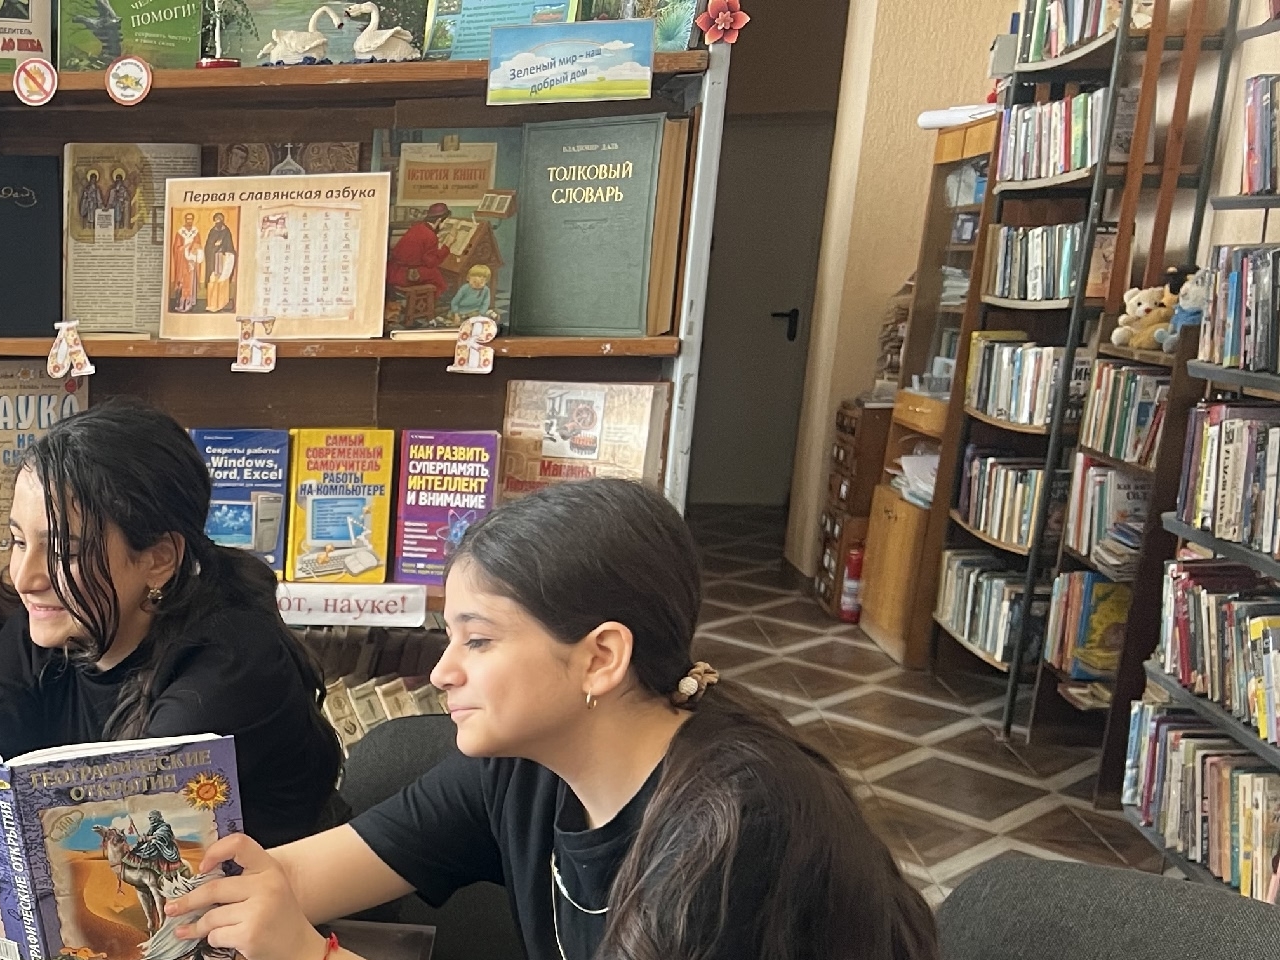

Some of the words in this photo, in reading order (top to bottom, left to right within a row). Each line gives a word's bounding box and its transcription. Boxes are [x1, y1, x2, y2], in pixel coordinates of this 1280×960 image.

[131, 3, 196, 27] ПОМОГИ!
[509, 57, 556, 81] Зеленый
[559, 54, 577, 67] мир
[585, 47, 602, 57] наш
[530, 71, 568, 96] добрый
[570, 68, 588, 82] дом
[407, 168, 449, 180] ИСТОРИЯ
[453, 168, 486, 180] КНИГИ
[548, 160, 633, 181] ТОЛКОВЫЙ
[183, 190, 235, 204] Первая
[239, 188, 321, 201] славянская
[325, 187, 376, 200] азбука
[551, 186, 624, 204] СЛОВАРЬ
[325, 434, 364, 446] САМЫЙ
[206, 446, 245, 455] Секреты
[306, 446, 383, 459] СОВРЕМЕННЫЙ
[410, 445, 434, 460] КАК
[437, 446, 490, 462] РАЗВИТЬ
[211, 456, 278, 469] Windows,
[307, 460, 381, 471] САМОУЧИТЕЛЬ
[409, 461, 490, 477] СУПЕРПАМЯТЬ,
[243, 469, 283, 480] Excel
[323, 472, 363, 483] РАБОТЫ
[316, 485, 385, 496] КОМПЬЮТЕРЕ
[408, 476, 488, 493] ИНТЕЛЛЕКТ
[407, 491, 416, 505] И
[418, 492, 486, 509] ВНИМАНИЕ
[324, 595, 408, 620] науке!
[31, 750, 212, 789] ГЕОГРАФИЧЕСКИЕ
[70, 774, 178, 801] ОТКРЫТИЯ
[0, 800, 24, 872] ОТКРЫТИЯ
